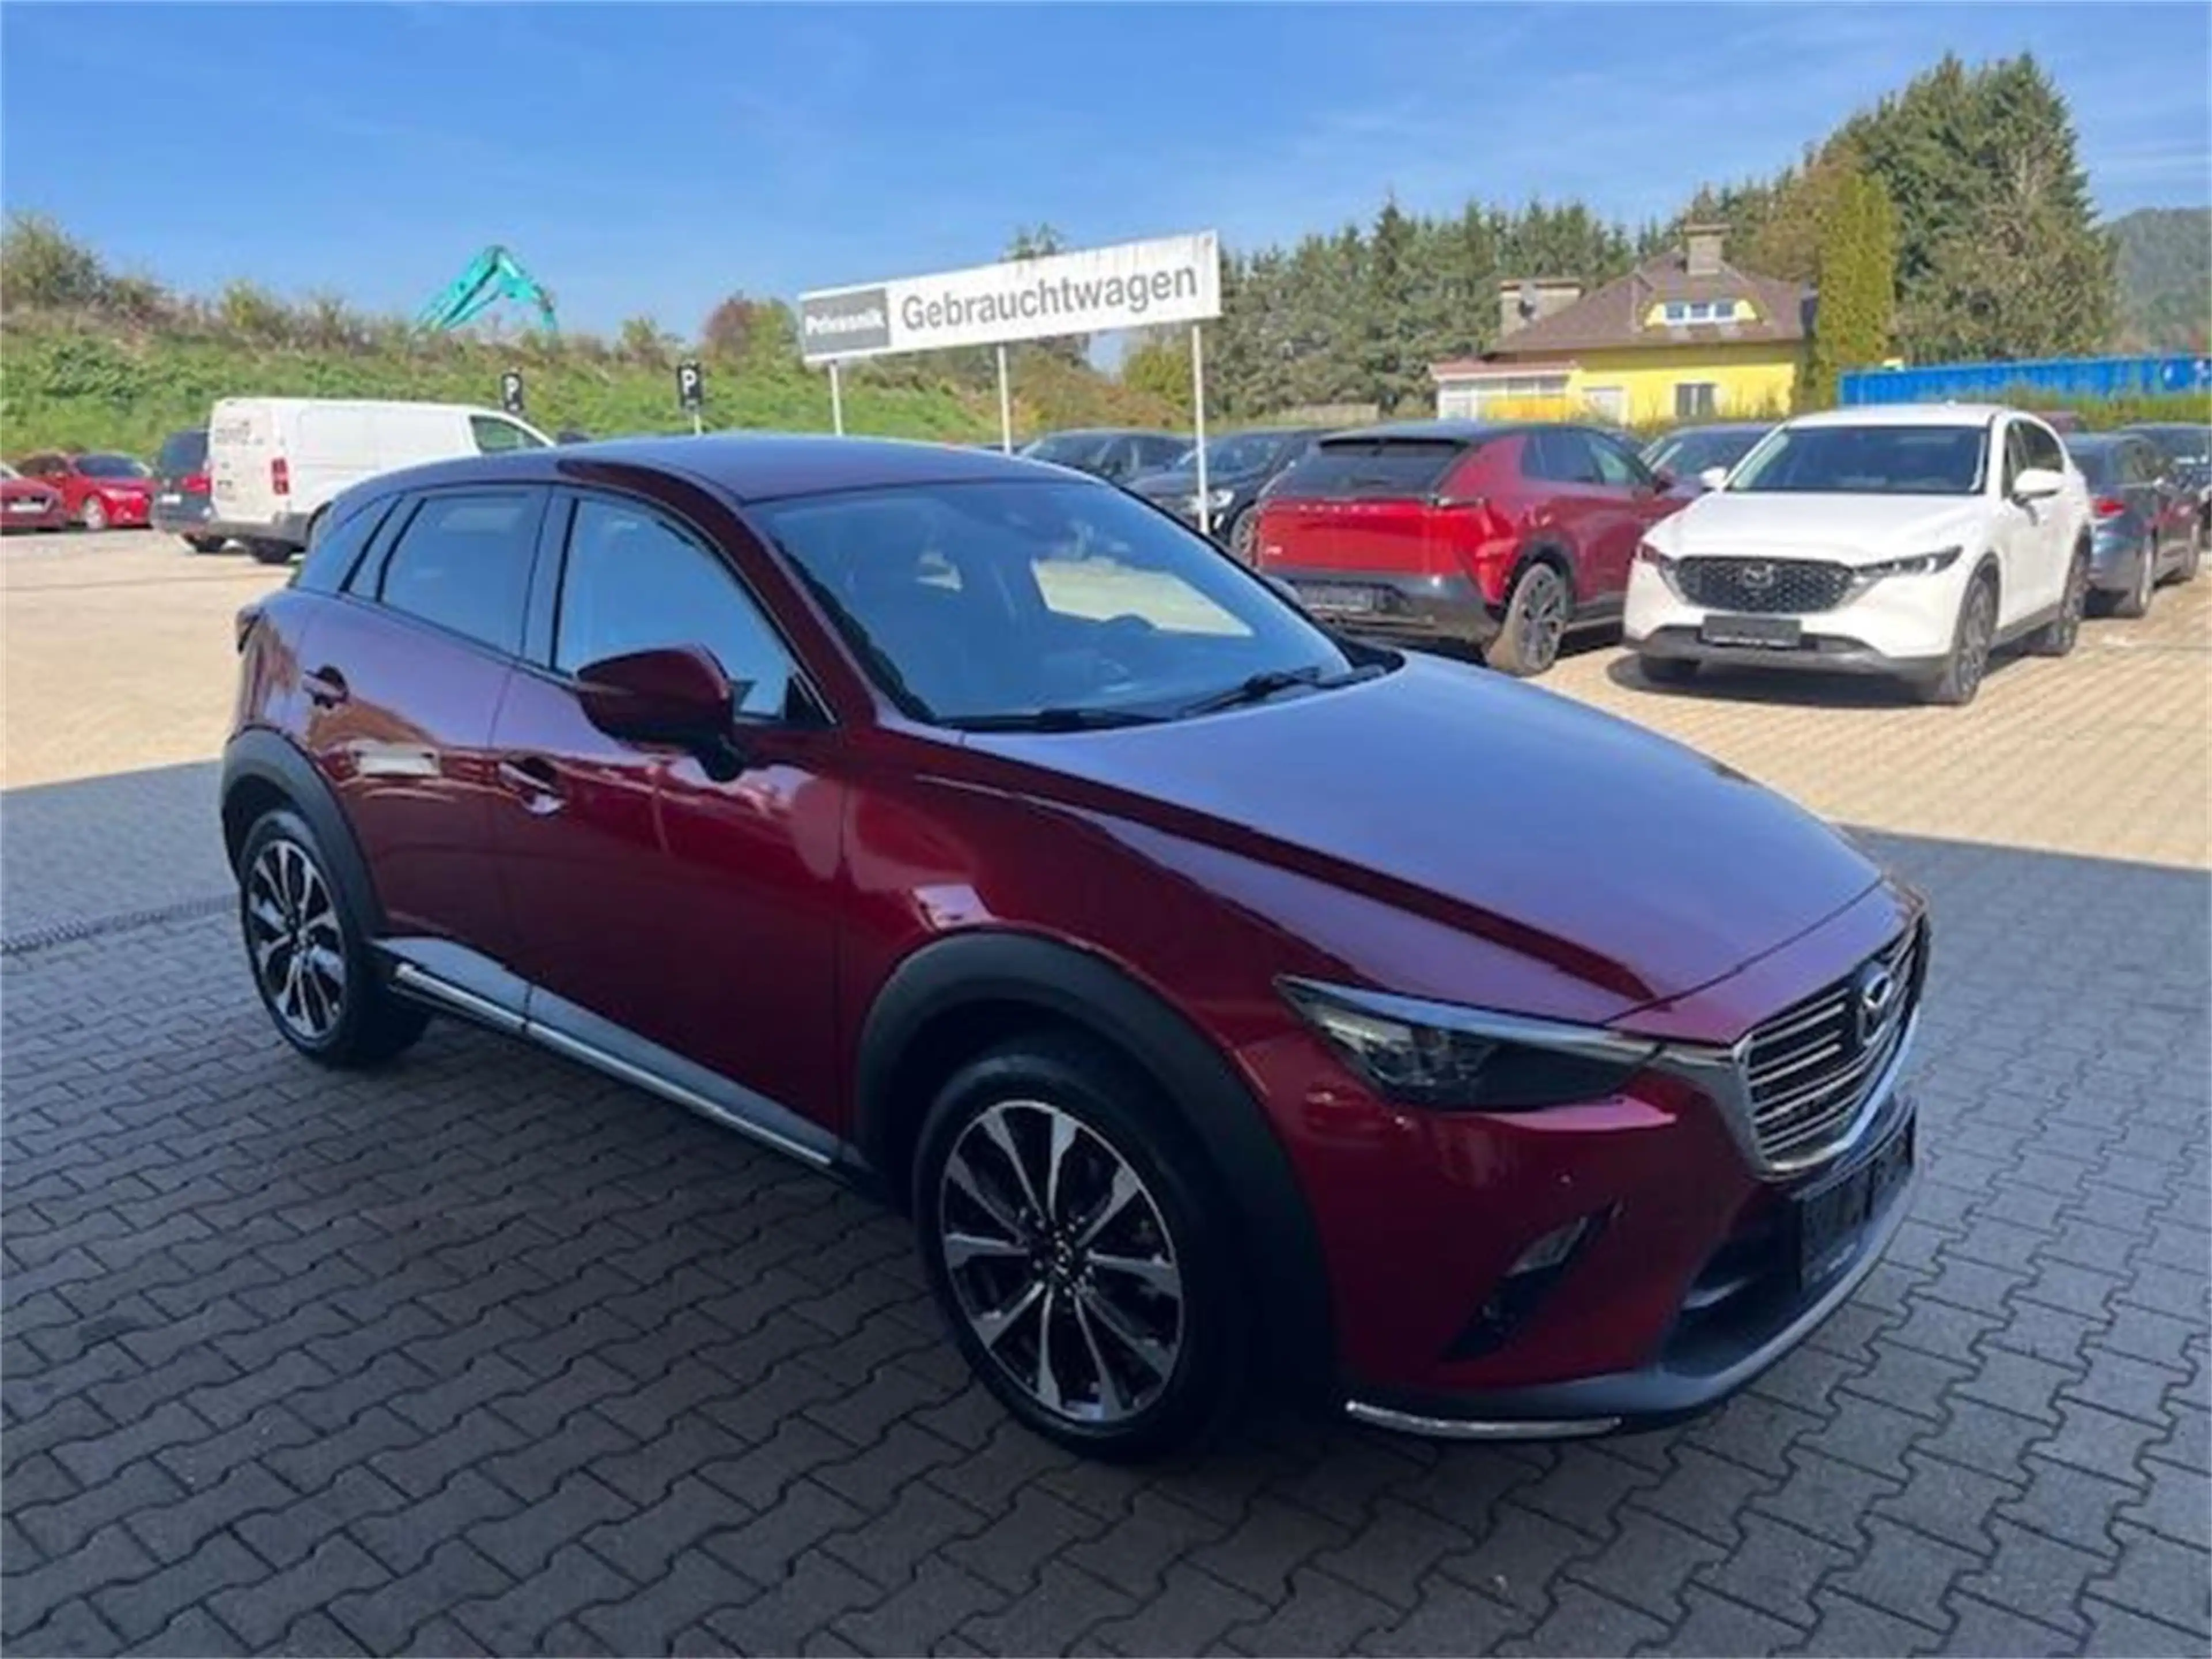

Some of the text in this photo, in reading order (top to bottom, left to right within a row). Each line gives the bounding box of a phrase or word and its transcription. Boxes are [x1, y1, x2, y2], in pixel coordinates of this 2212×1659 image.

[901, 265, 1198, 331] Gebrauchtwagen
[505, 376, 518, 401] P
[681, 368, 698, 395] P
